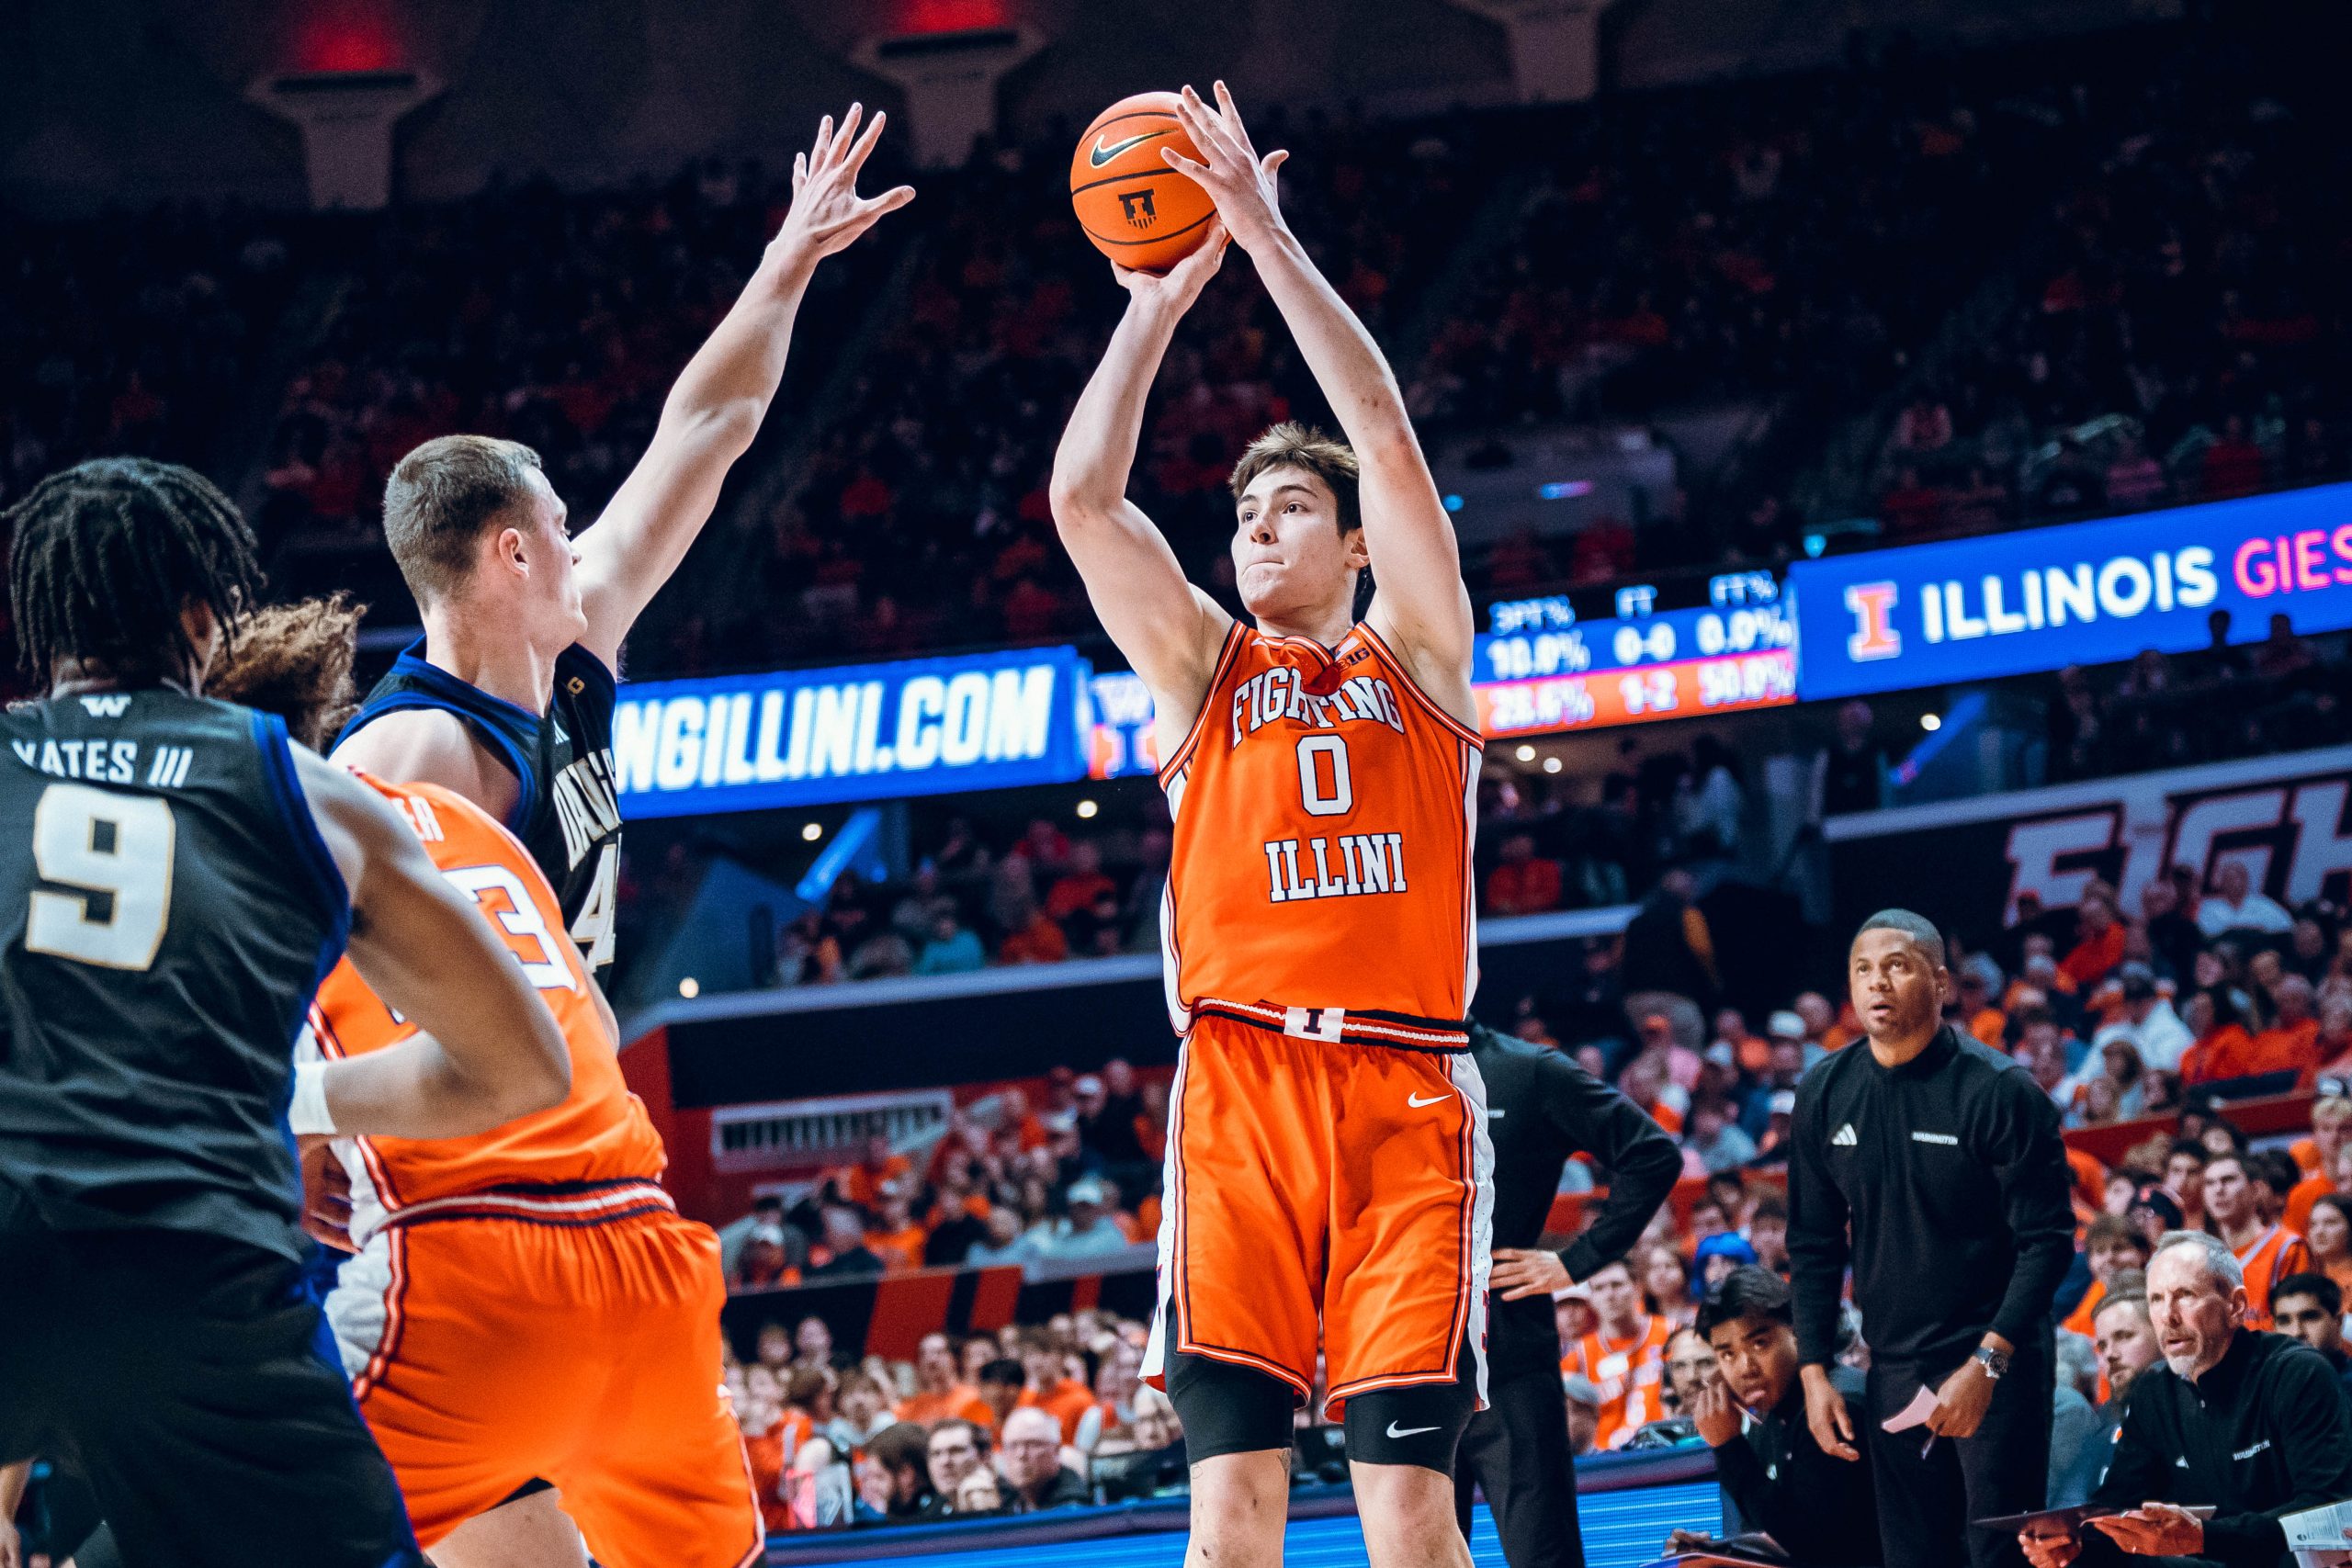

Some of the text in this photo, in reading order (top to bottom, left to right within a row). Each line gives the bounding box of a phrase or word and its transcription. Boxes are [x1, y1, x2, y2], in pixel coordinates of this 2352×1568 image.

[1920, 546, 2219, 643] ILLINOIS
[79, 694, 132, 717] W
[1233, 666, 1405, 750] FIGHTING
[12, 738, 138, 784] YATES
[1296, 735, 1353, 817] 0
[25, 784, 177, 972] 9
[570, 831, 623, 976] 4
[1263, 833, 1408, 903] ILLINI
[439, 863, 578, 992] 3
